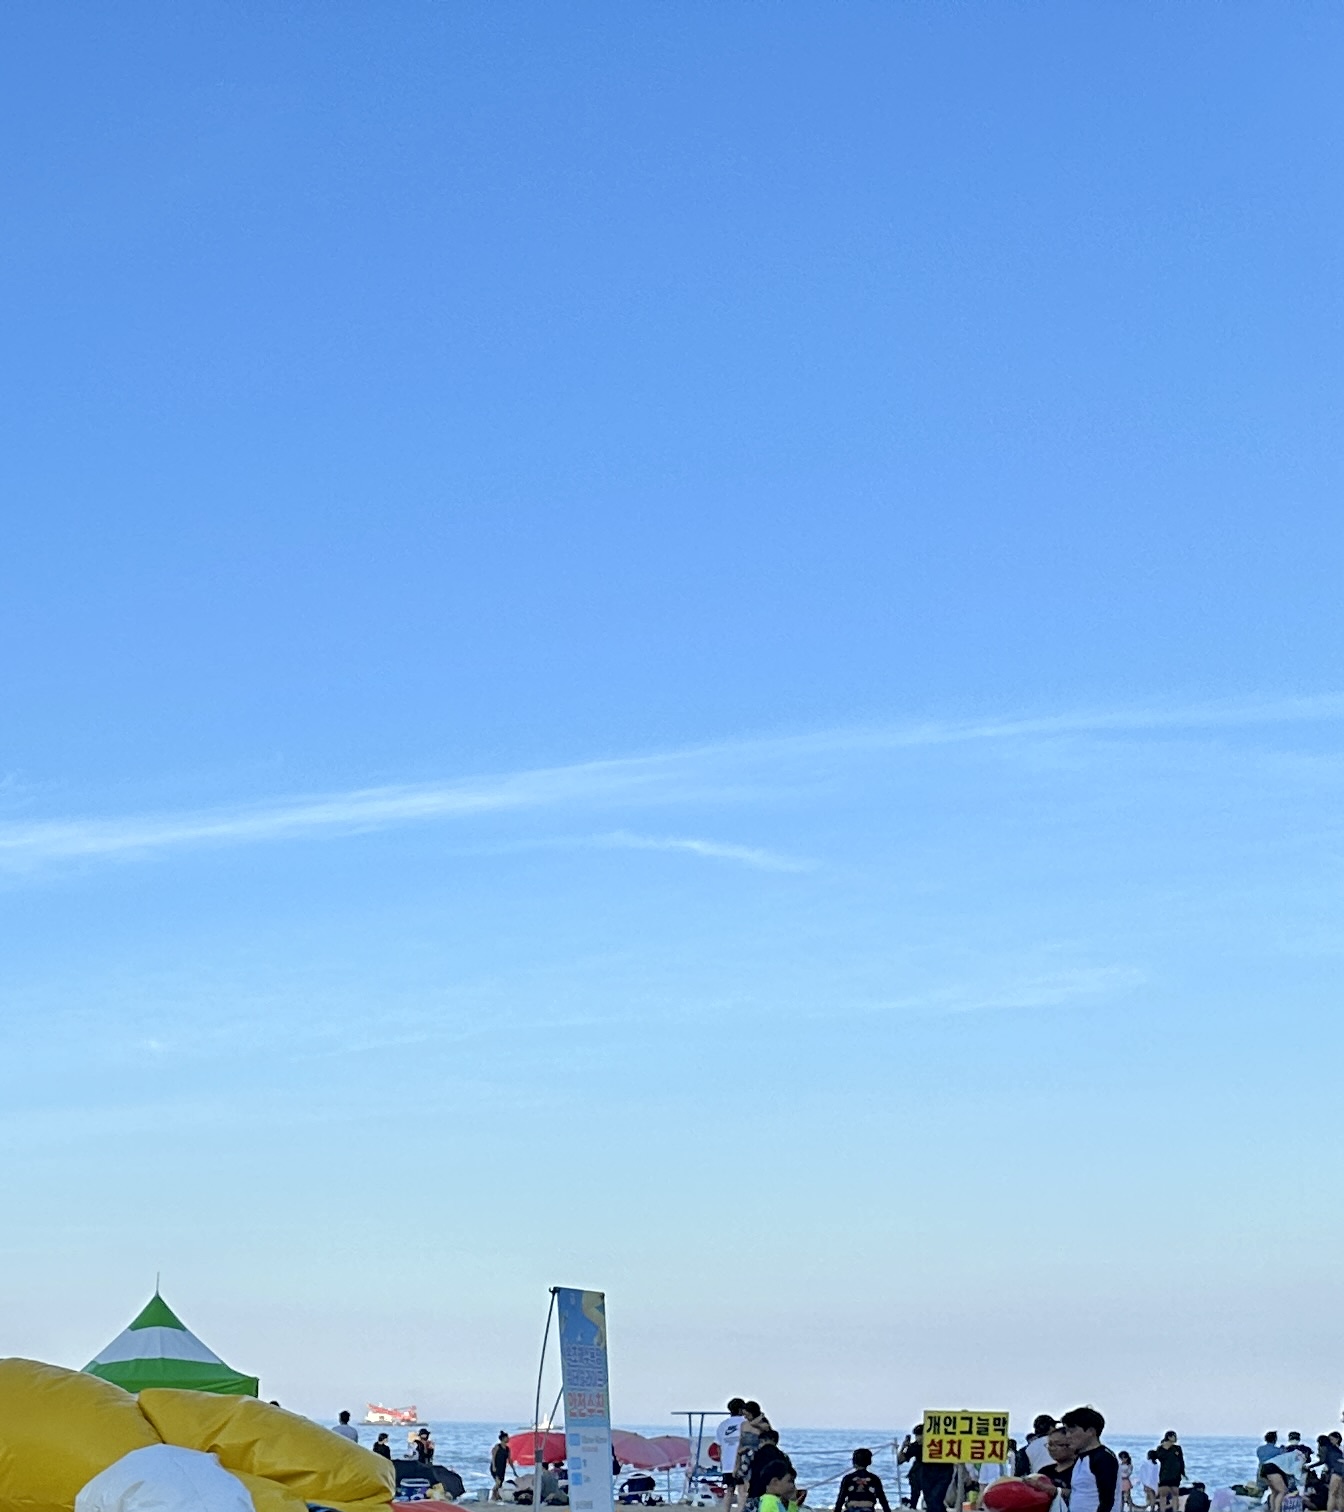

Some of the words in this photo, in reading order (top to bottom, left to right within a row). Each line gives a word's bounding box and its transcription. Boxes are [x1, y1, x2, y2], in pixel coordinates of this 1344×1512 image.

[926, 1416, 1007, 1436] 개인그늘막
[927, 1439, 962, 1460] 설치
[970, 1440, 1005, 1460] 금지
